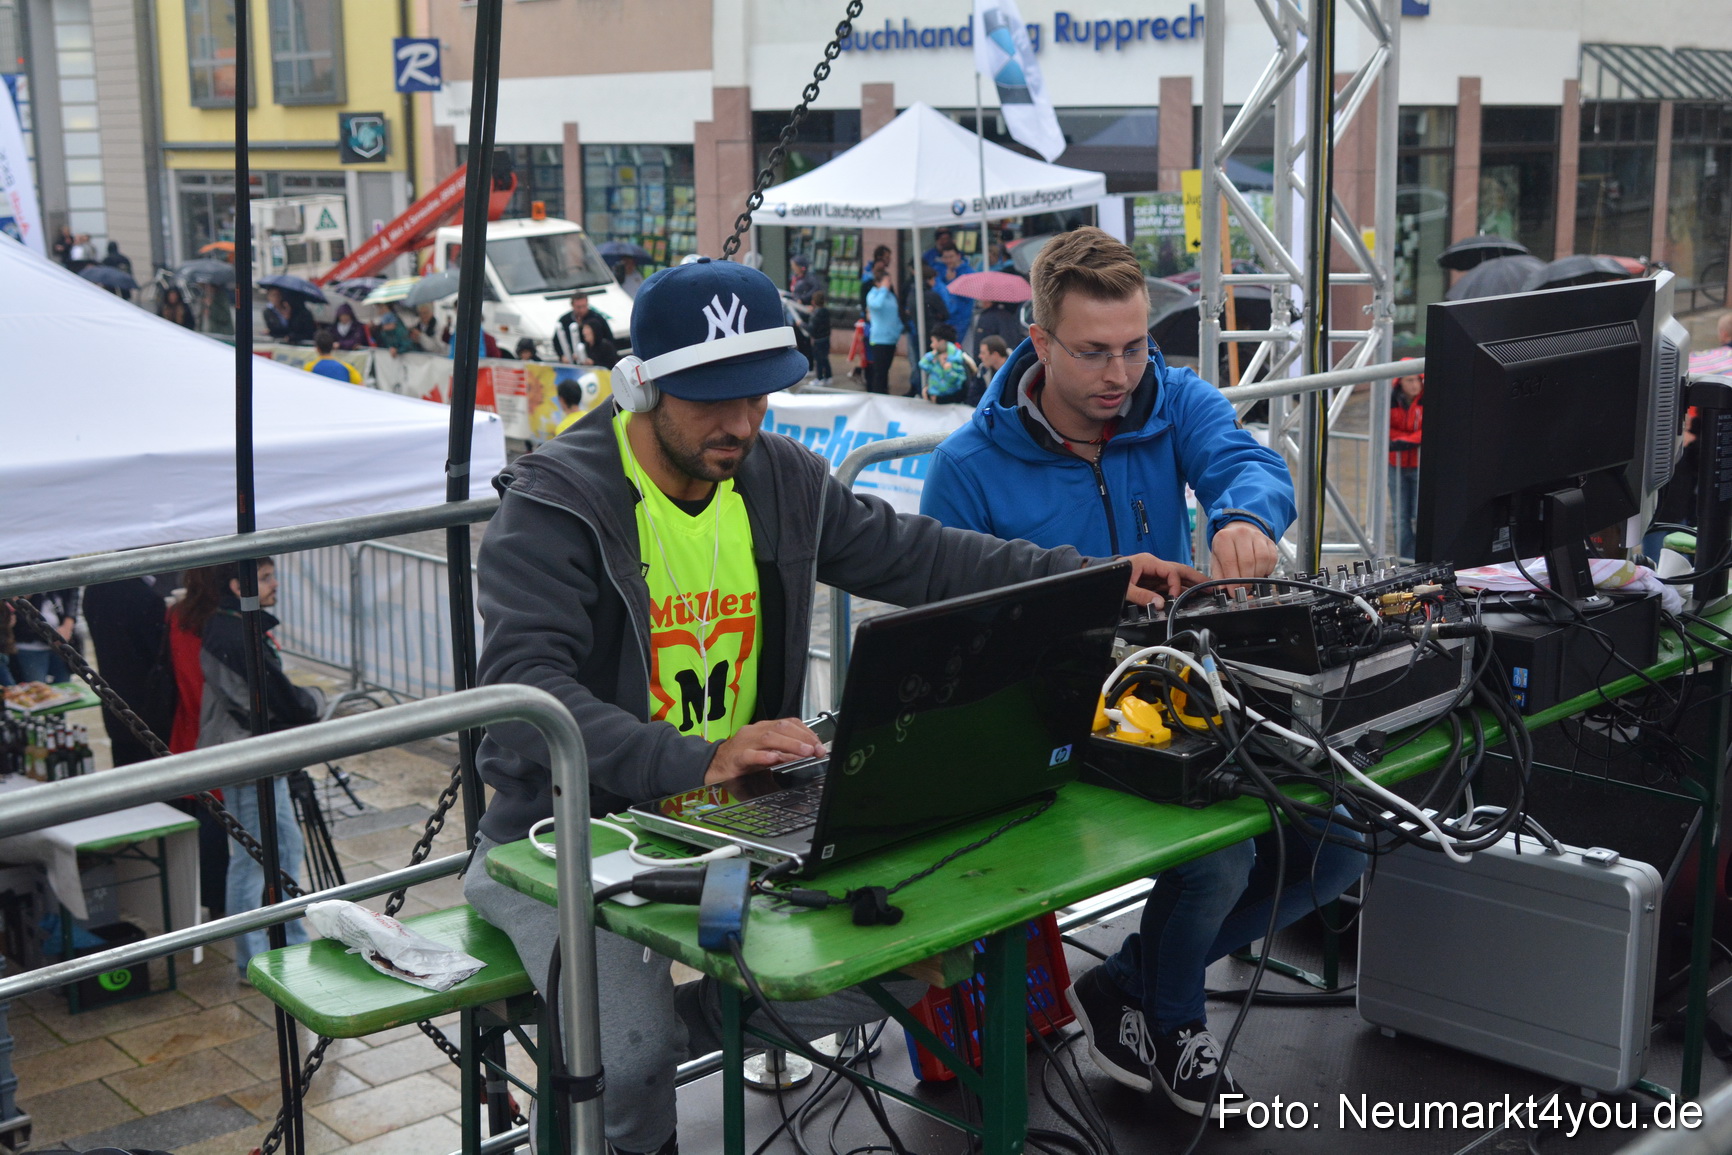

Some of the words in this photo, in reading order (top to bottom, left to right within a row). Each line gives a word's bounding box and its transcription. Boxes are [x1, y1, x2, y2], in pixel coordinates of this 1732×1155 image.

[1054, 3, 1205, 51] Rupprech
[824, 202, 882, 222] Laufsport
[973, 194, 1009, 212] BMW
[1011, 188, 1073, 208] Laufsport
[650, 588, 757, 629] Müller
